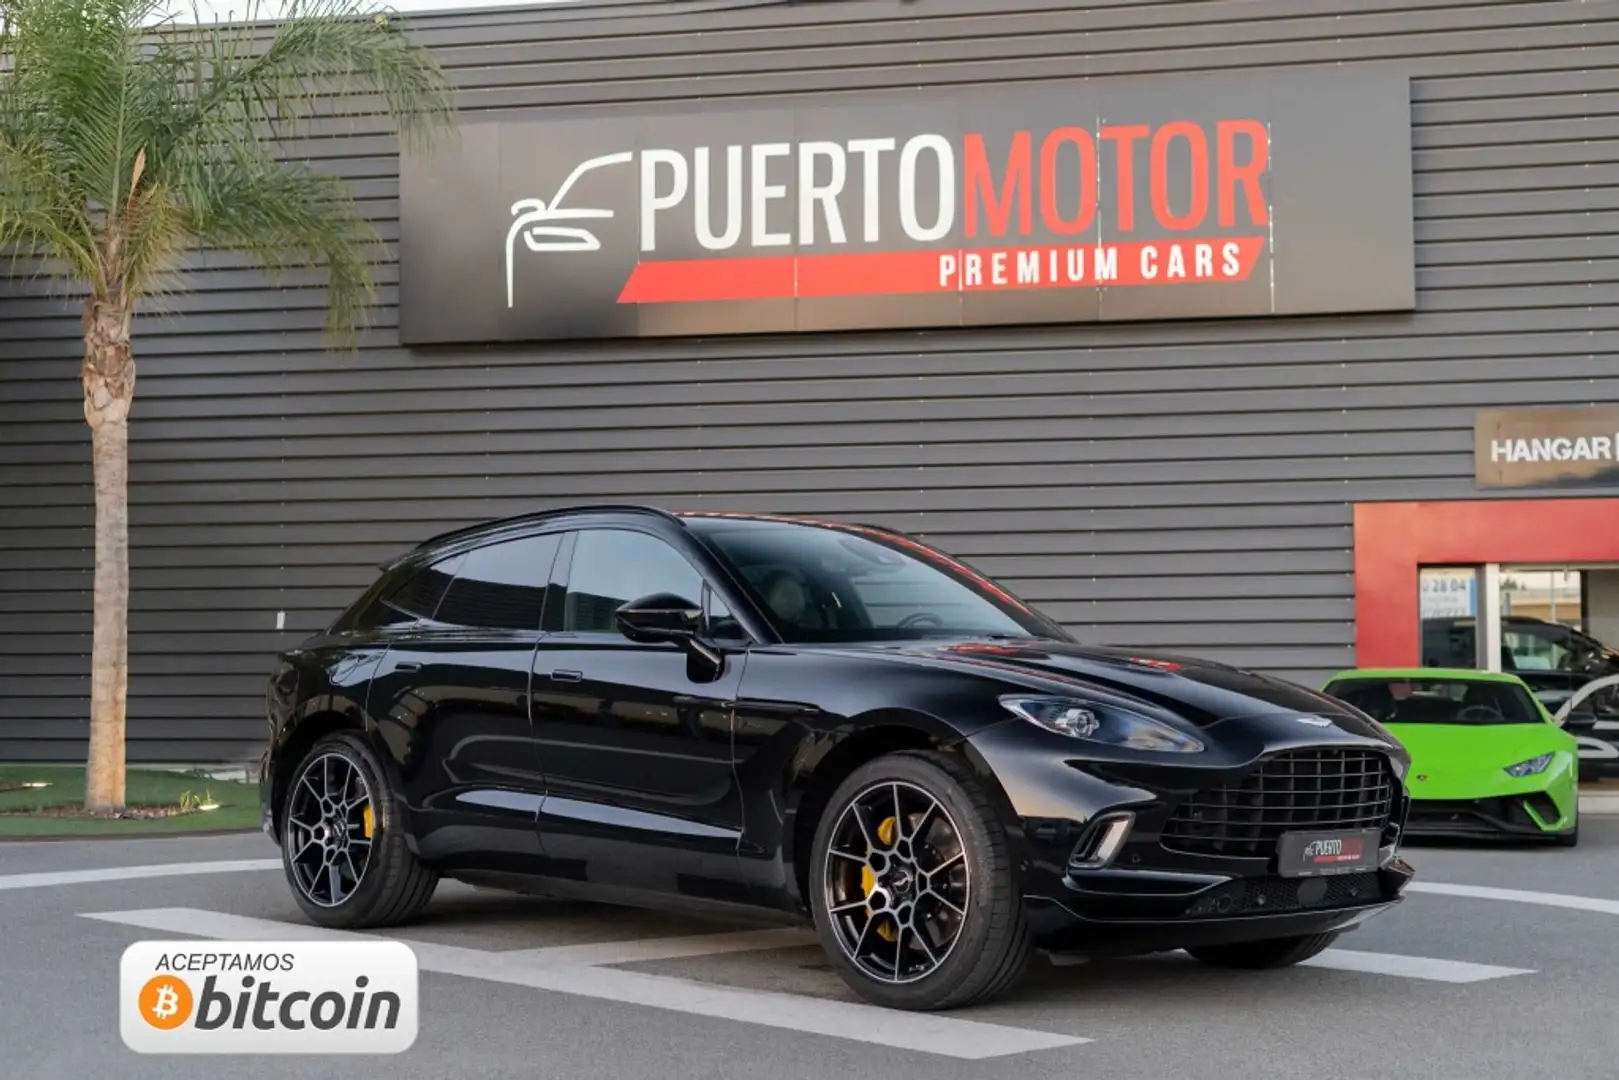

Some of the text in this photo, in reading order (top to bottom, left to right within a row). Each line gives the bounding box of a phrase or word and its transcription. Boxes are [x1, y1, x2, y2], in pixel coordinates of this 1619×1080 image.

[938, 241, 1242, 288] PREMIUM CARS
[1491, 437, 1612, 462] HANGAR
